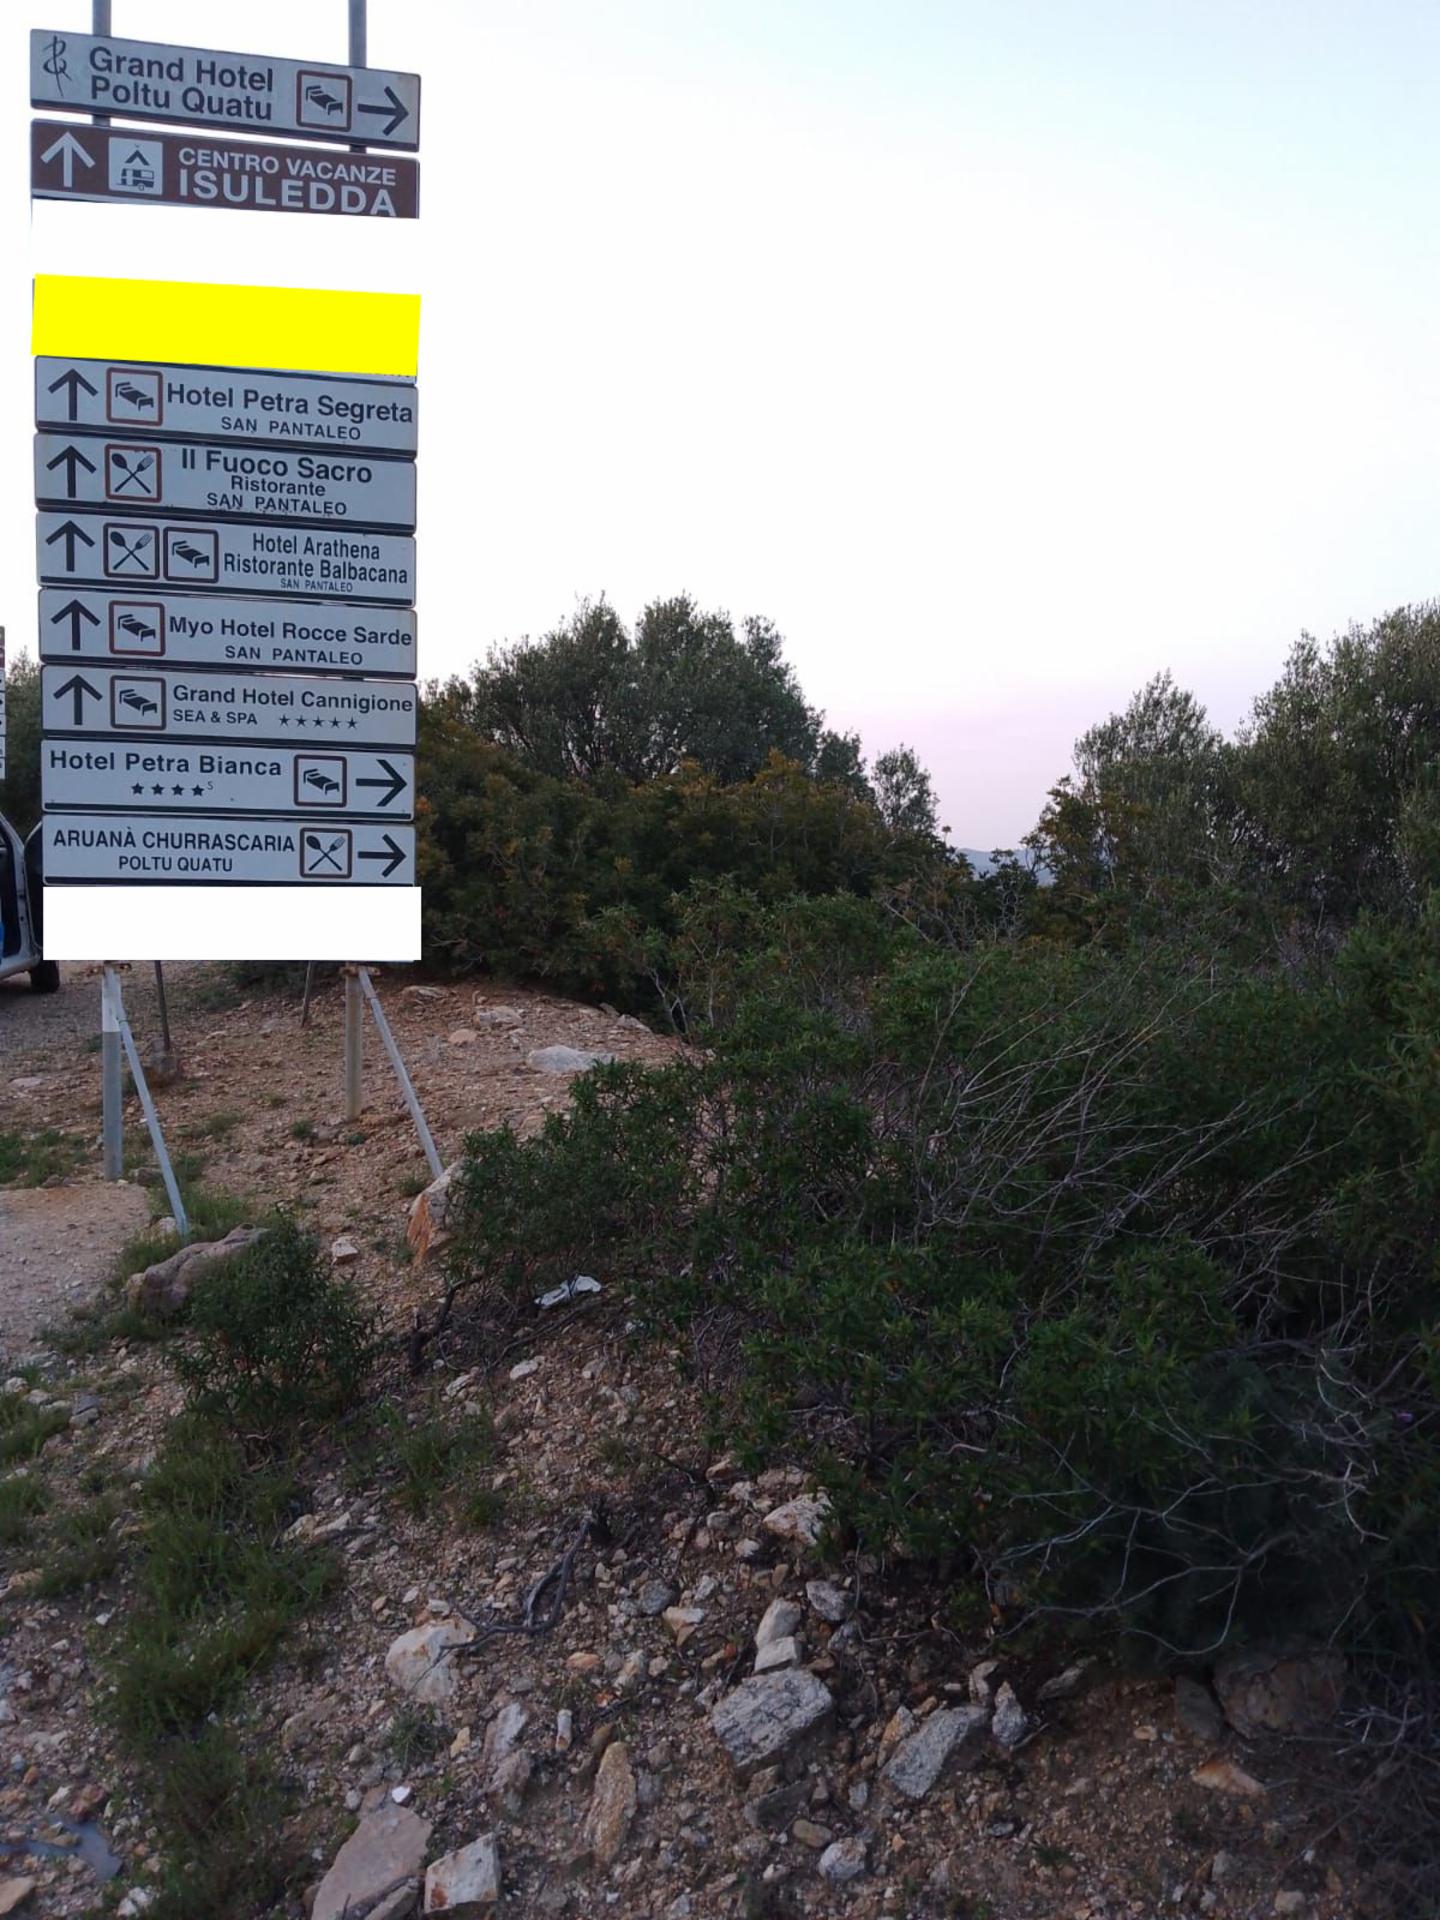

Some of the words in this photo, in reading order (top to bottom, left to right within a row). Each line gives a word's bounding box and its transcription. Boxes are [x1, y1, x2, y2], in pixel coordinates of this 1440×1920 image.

[89, 46, 184, 81] Grand
[198, 61, 273, 92] Hotel
[90, 76, 170, 108] Poltu
[182, 87, 272, 120] Quatu
[179, 148, 278, 174] CENTRO
[286, 158, 396, 186] VACANZE
[179, 171, 397, 216] ISULEDDA
[167, 383, 233, 407] Hotel
[243, 390, 308, 414] Petra
[317, 394, 413, 424] Segreta
[221, 416, 257, 432] SAN
[269, 420, 361, 440] PANTALEO
[206, 450, 288, 476] Fuoco
[297, 456, 372, 483] Sacro
[231, 476, 326, 496] Ristorante
[207, 493, 243, 507] SAN
[255, 496, 347, 516] PANTALEO
[253, 533, 297, 554] Hotel
[303, 536, 380, 560] Arathena
[224, 553, 314, 578] Ristorante
[320, 559, 408, 583] Balbacana
[280, 578, 300, 589] SAN
[305, 580, 353, 592] PANTALEO
[169, 616, 213, 638] Myo
[221, 619, 274, 638] Hotel
[282, 623, 347, 643] Rocce
[354, 627, 412, 646] Sarde
[225, 645, 261, 659] SAN
[273, 648, 363, 665] PANTALEO
[173, 685, 235, 703] Grand
[243, 688, 294, 707] Hotel
[301, 692, 413, 713] Cannigione
[173, 709, 206, 722] SEA
[210, 711, 221, 724] &
[227, 712, 257, 725] SPA
[51, 750, 115, 770] Hotel
[125, 753, 189, 773] Petra
[200, 755, 282, 776] Bianca
[54, 826, 136, 847] ARUANÀ
[142, 832, 295, 853] CHURRASCARIA
[119, 856, 172, 871] POLTU
[177, 857, 233, 872] QUATU
